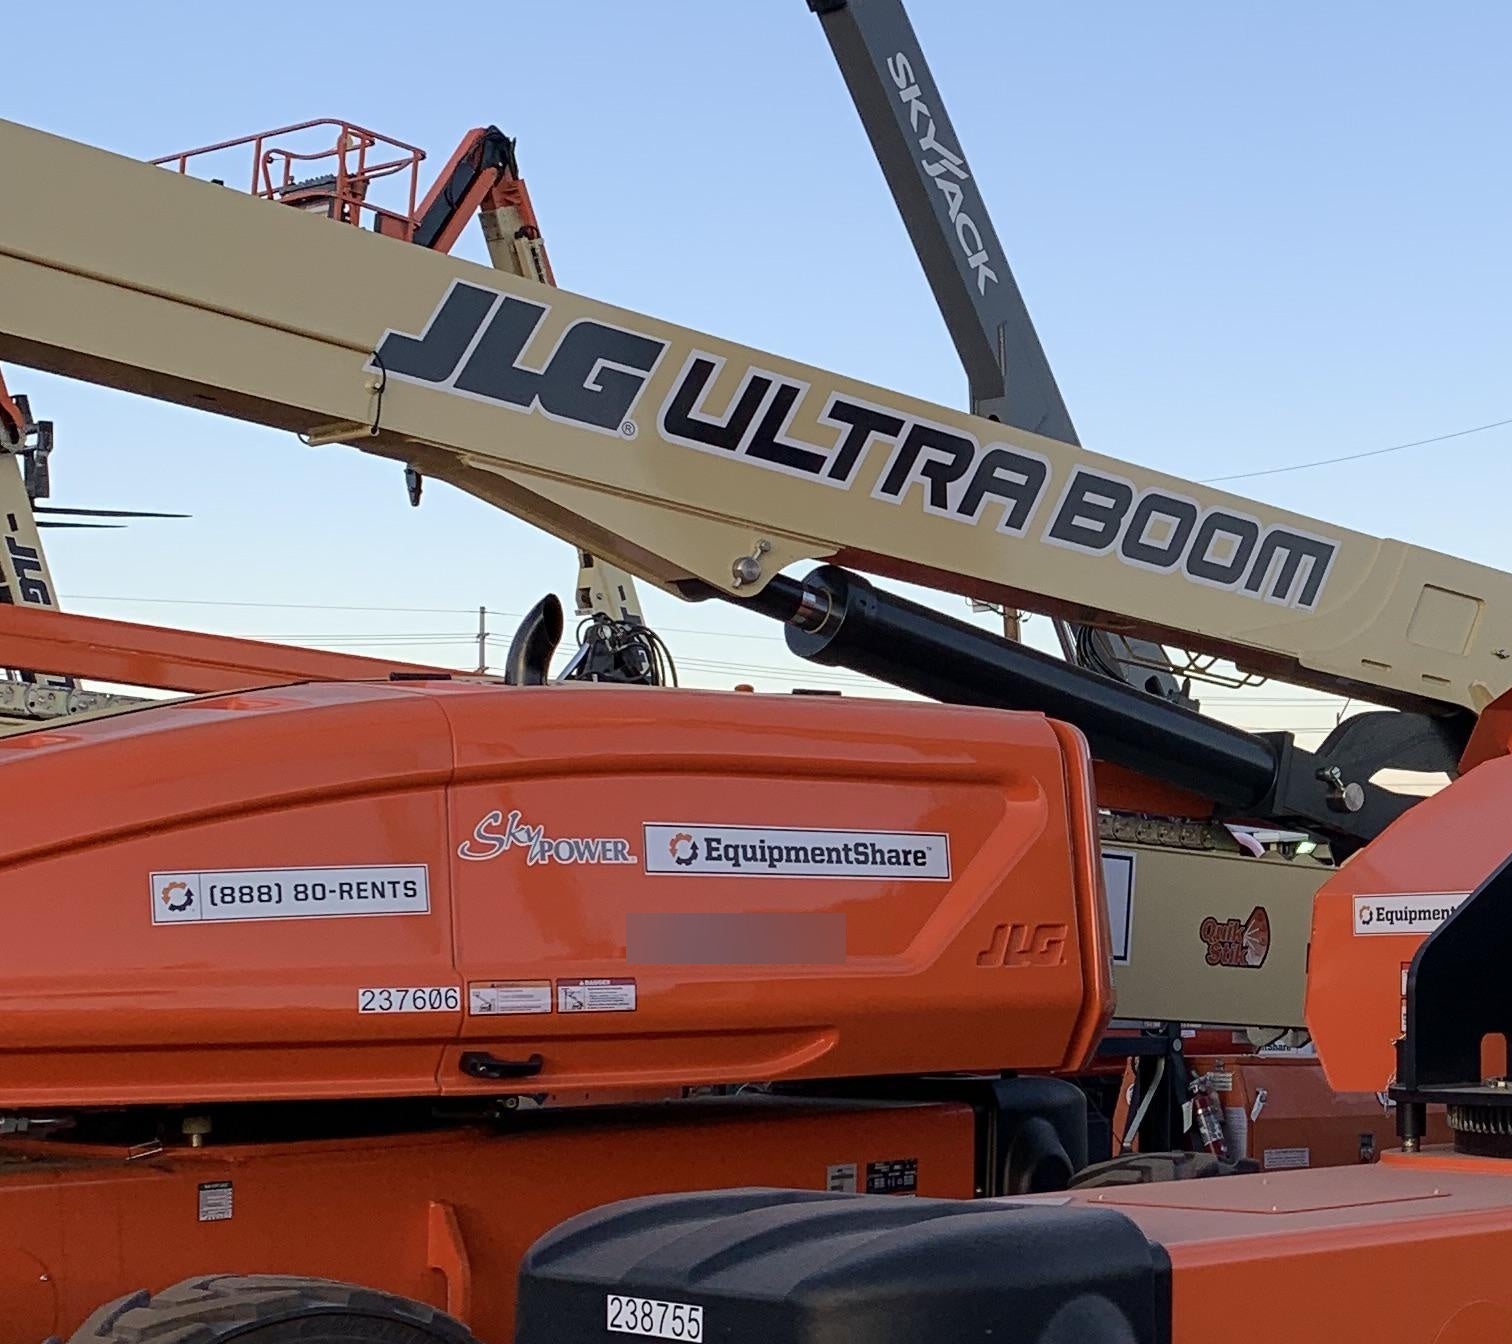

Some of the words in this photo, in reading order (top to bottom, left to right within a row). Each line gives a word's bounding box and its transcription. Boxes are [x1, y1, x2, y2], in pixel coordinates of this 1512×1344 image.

[887, 52, 999, 296] SKYJACK
[363, 278, 672, 437] JLG
[658, 349, 1053, 540] ULTRA
[1041, 463, 1341, 614] BOOM
[5, 535, 52, 606] JLG
[704, 836, 928, 868] EquipmentShare
[293, 880, 418, 902] 80-RENTS
[976, 923, 1068, 968] JLG
[361, 988, 459, 1012] 237606
[610, 1297, 700, 1340] 238755
